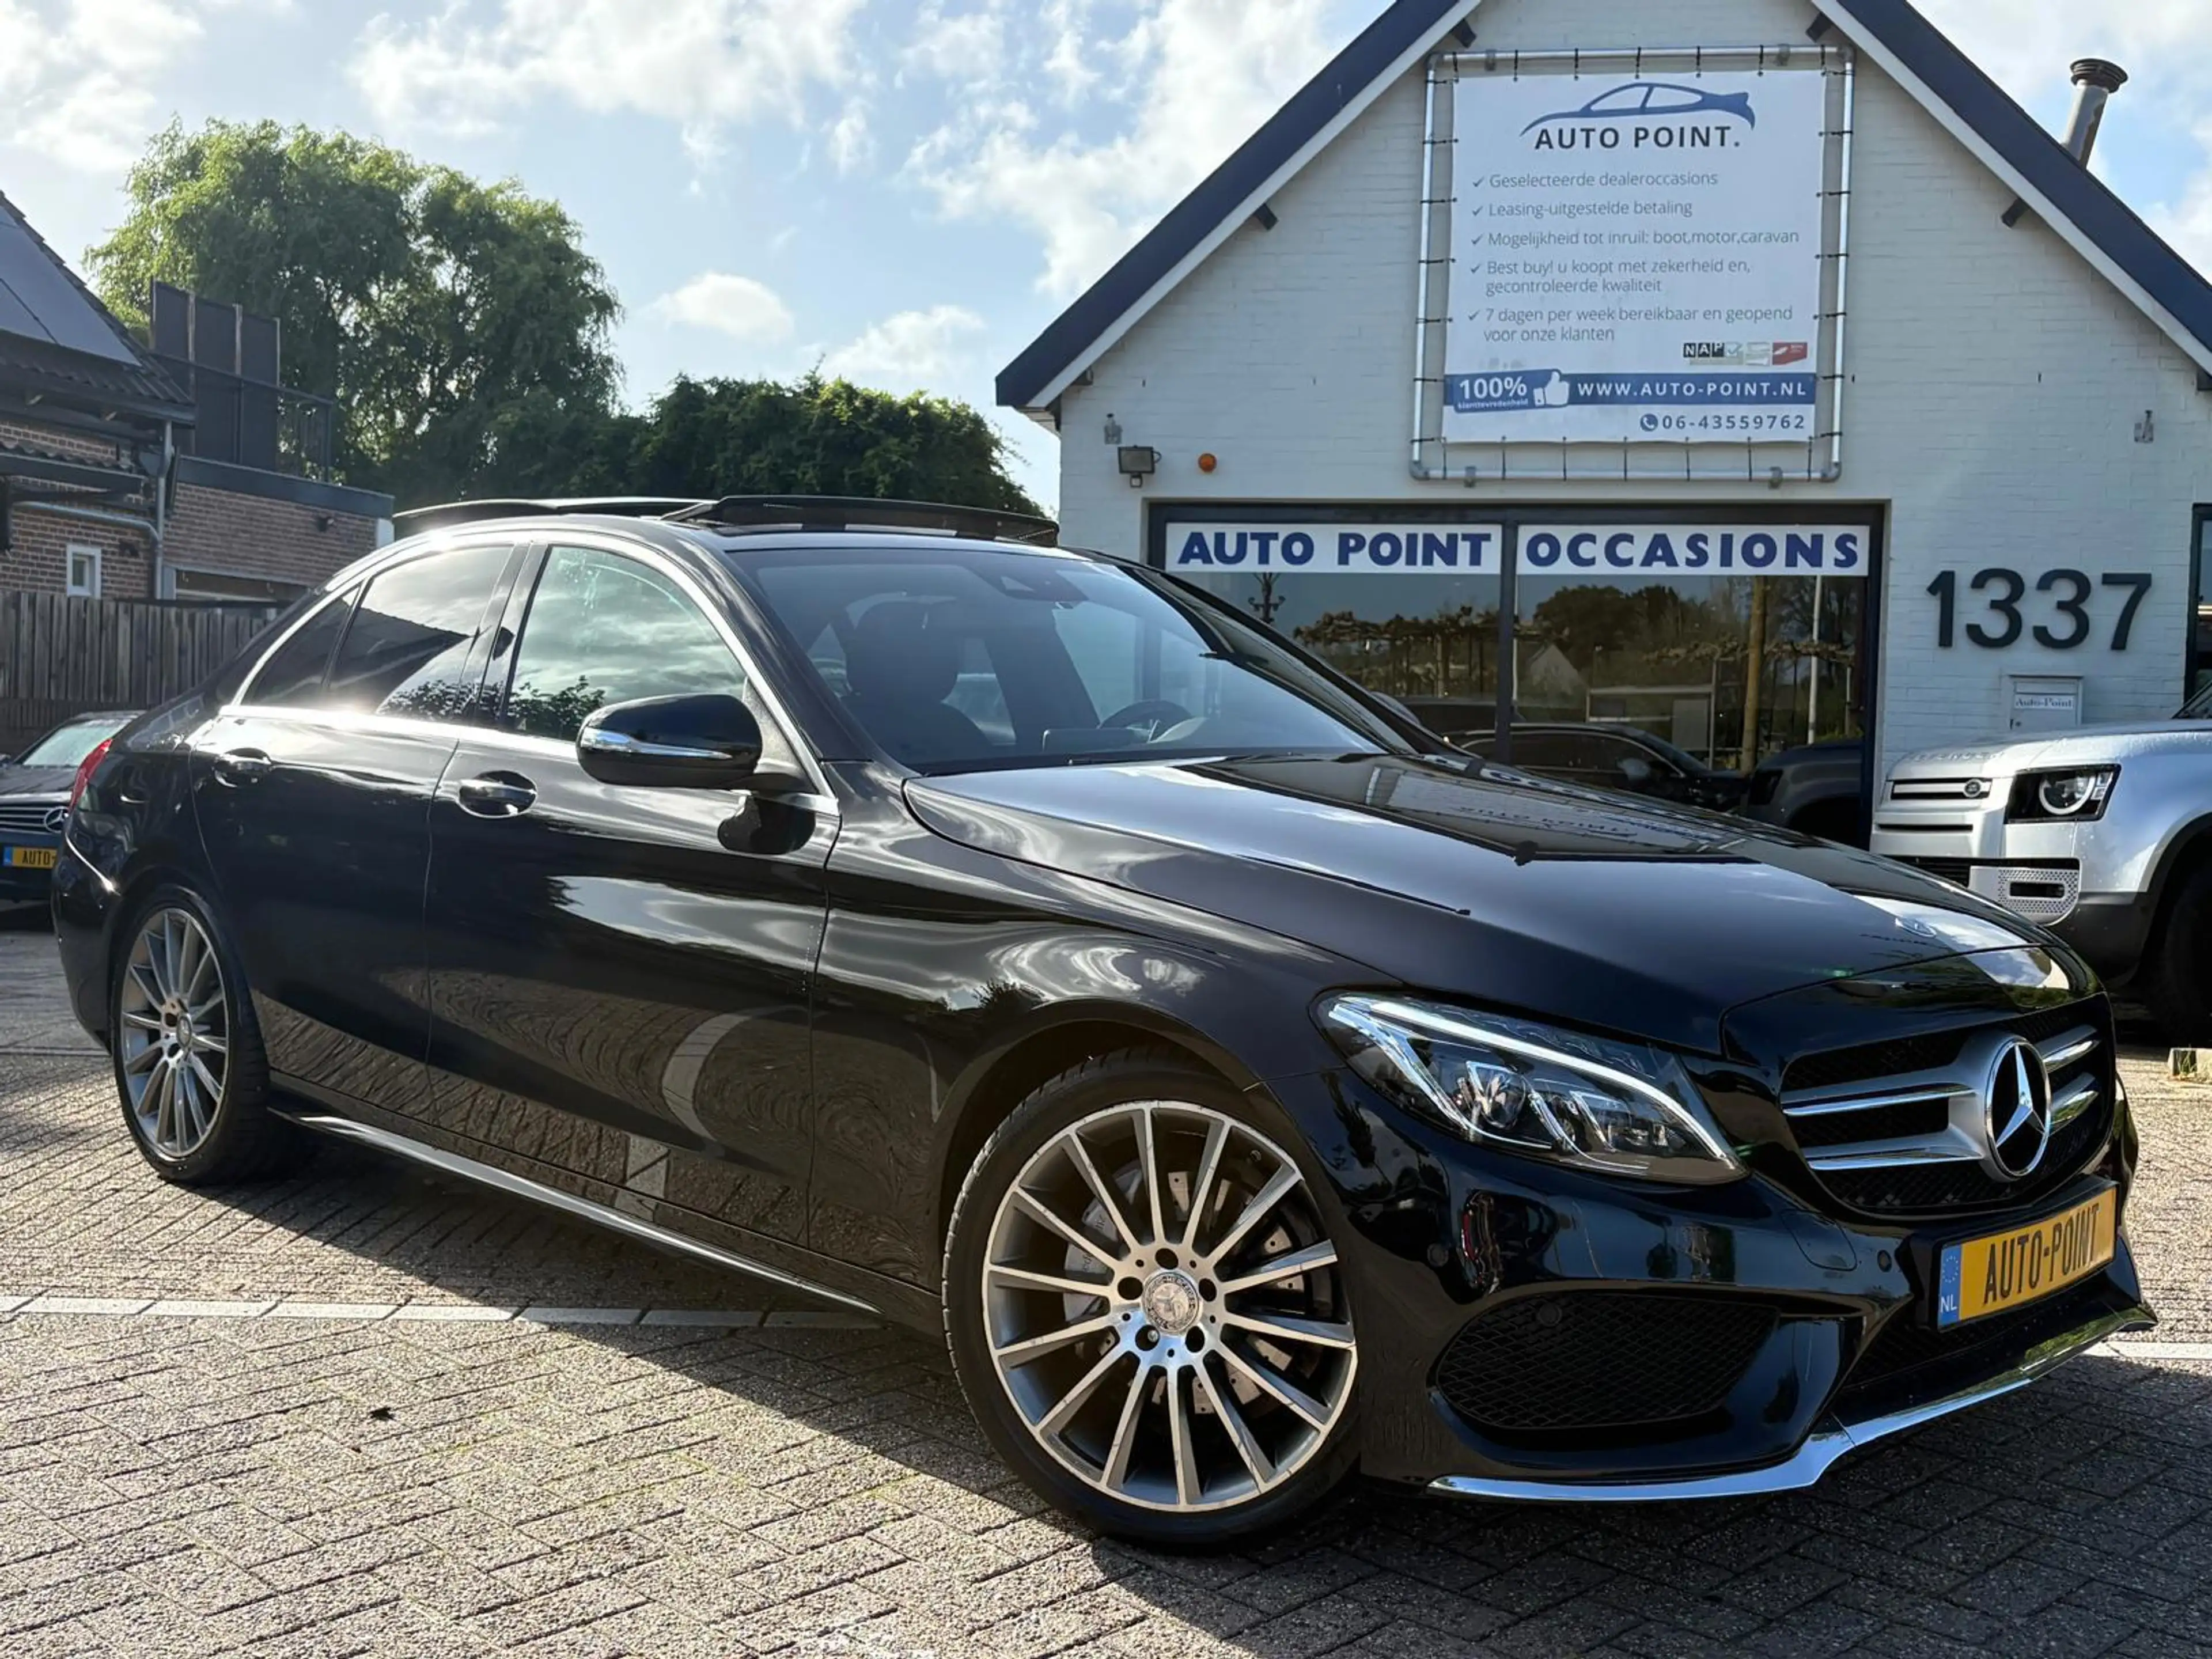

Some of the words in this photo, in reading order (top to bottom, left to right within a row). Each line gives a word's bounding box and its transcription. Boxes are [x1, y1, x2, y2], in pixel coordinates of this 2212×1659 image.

[1535, 127, 1619, 149] AUTO
[1634, 126, 1740, 147] POINT.
[1489, 172, 1595, 188] Geselecteerde
[1599, 172, 1718, 186] dealeroccasions
[1489, 202, 1629, 219] Leasing-uitgestelde
[1634, 200, 1692, 218] betaling
[1488, 231, 1579, 249] Mogelijkheid
[1584, 232, 1603, 244] tot
[1608, 230, 1649, 244] inruil:
[1487, 261, 1518, 274] Best
[1524, 260, 1553, 276] buy!
[1558, 262, 1567, 274] u
[1572, 259, 1613, 276] koopt
[1618, 260, 1646, 272] met
[1651, 259, 1724, 273] zekerheid
[1728, 260, 1751, 273] en,
[1486, 279, 1599, 297] gecontroleerde
[1602, 278, 1661, 292] kwaliteit
[1486, 308, 1494, 321] 7
[1498, 308, 1544, 325] dagen
[1548, 310, 1572, 325] per
[1577, 307, 1615, 321] week
[1619, 306, 1699, 320] bereikbaar
[1703, 308, 1722, 320] en
[1726, 305, 1793, 323] geopend
[1484, 329, 1517, 342] voor
[1521, 329, 1556, 342] onze
[1560, 326, 1615, 341] klanten
[1684, 343, 1724, 357] NAP
[1460, 377, 1527, 399] 100%
[1578, 382, 1806, 396] WWW.AUTO-POINT.NL
[1662, 415, 1804, 430] 06-43559762
[1178, 532, 1315, 565] AUTO
[1338, 532, 1492, 566] POINT
[1526, 533, 1858, 567] OCCASIONS
[1926, 567, 2152, 651] 1337
[2016, 697, 2072, 707] Auto-Point
[1940, 1294, 1957, 1313] NL
[1983, 1203, 2100, 1306] AUTO-POINT
